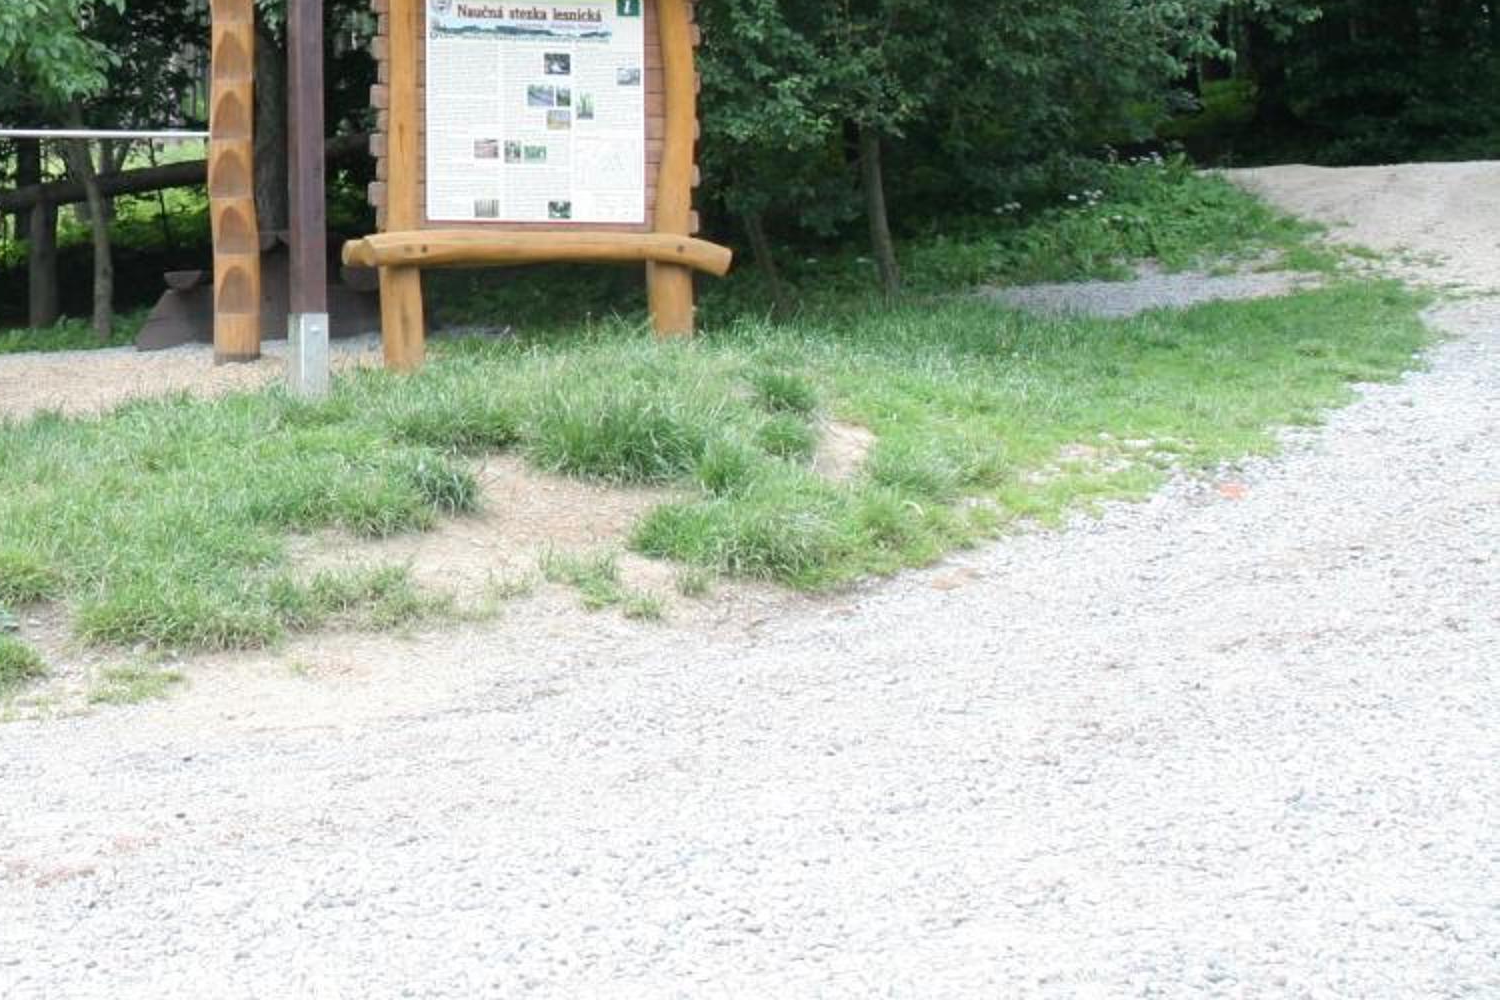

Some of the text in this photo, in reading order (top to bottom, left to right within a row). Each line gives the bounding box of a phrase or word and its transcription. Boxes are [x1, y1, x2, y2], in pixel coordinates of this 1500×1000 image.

[457, 4, 602, 22] Naučná stezka lesnická
